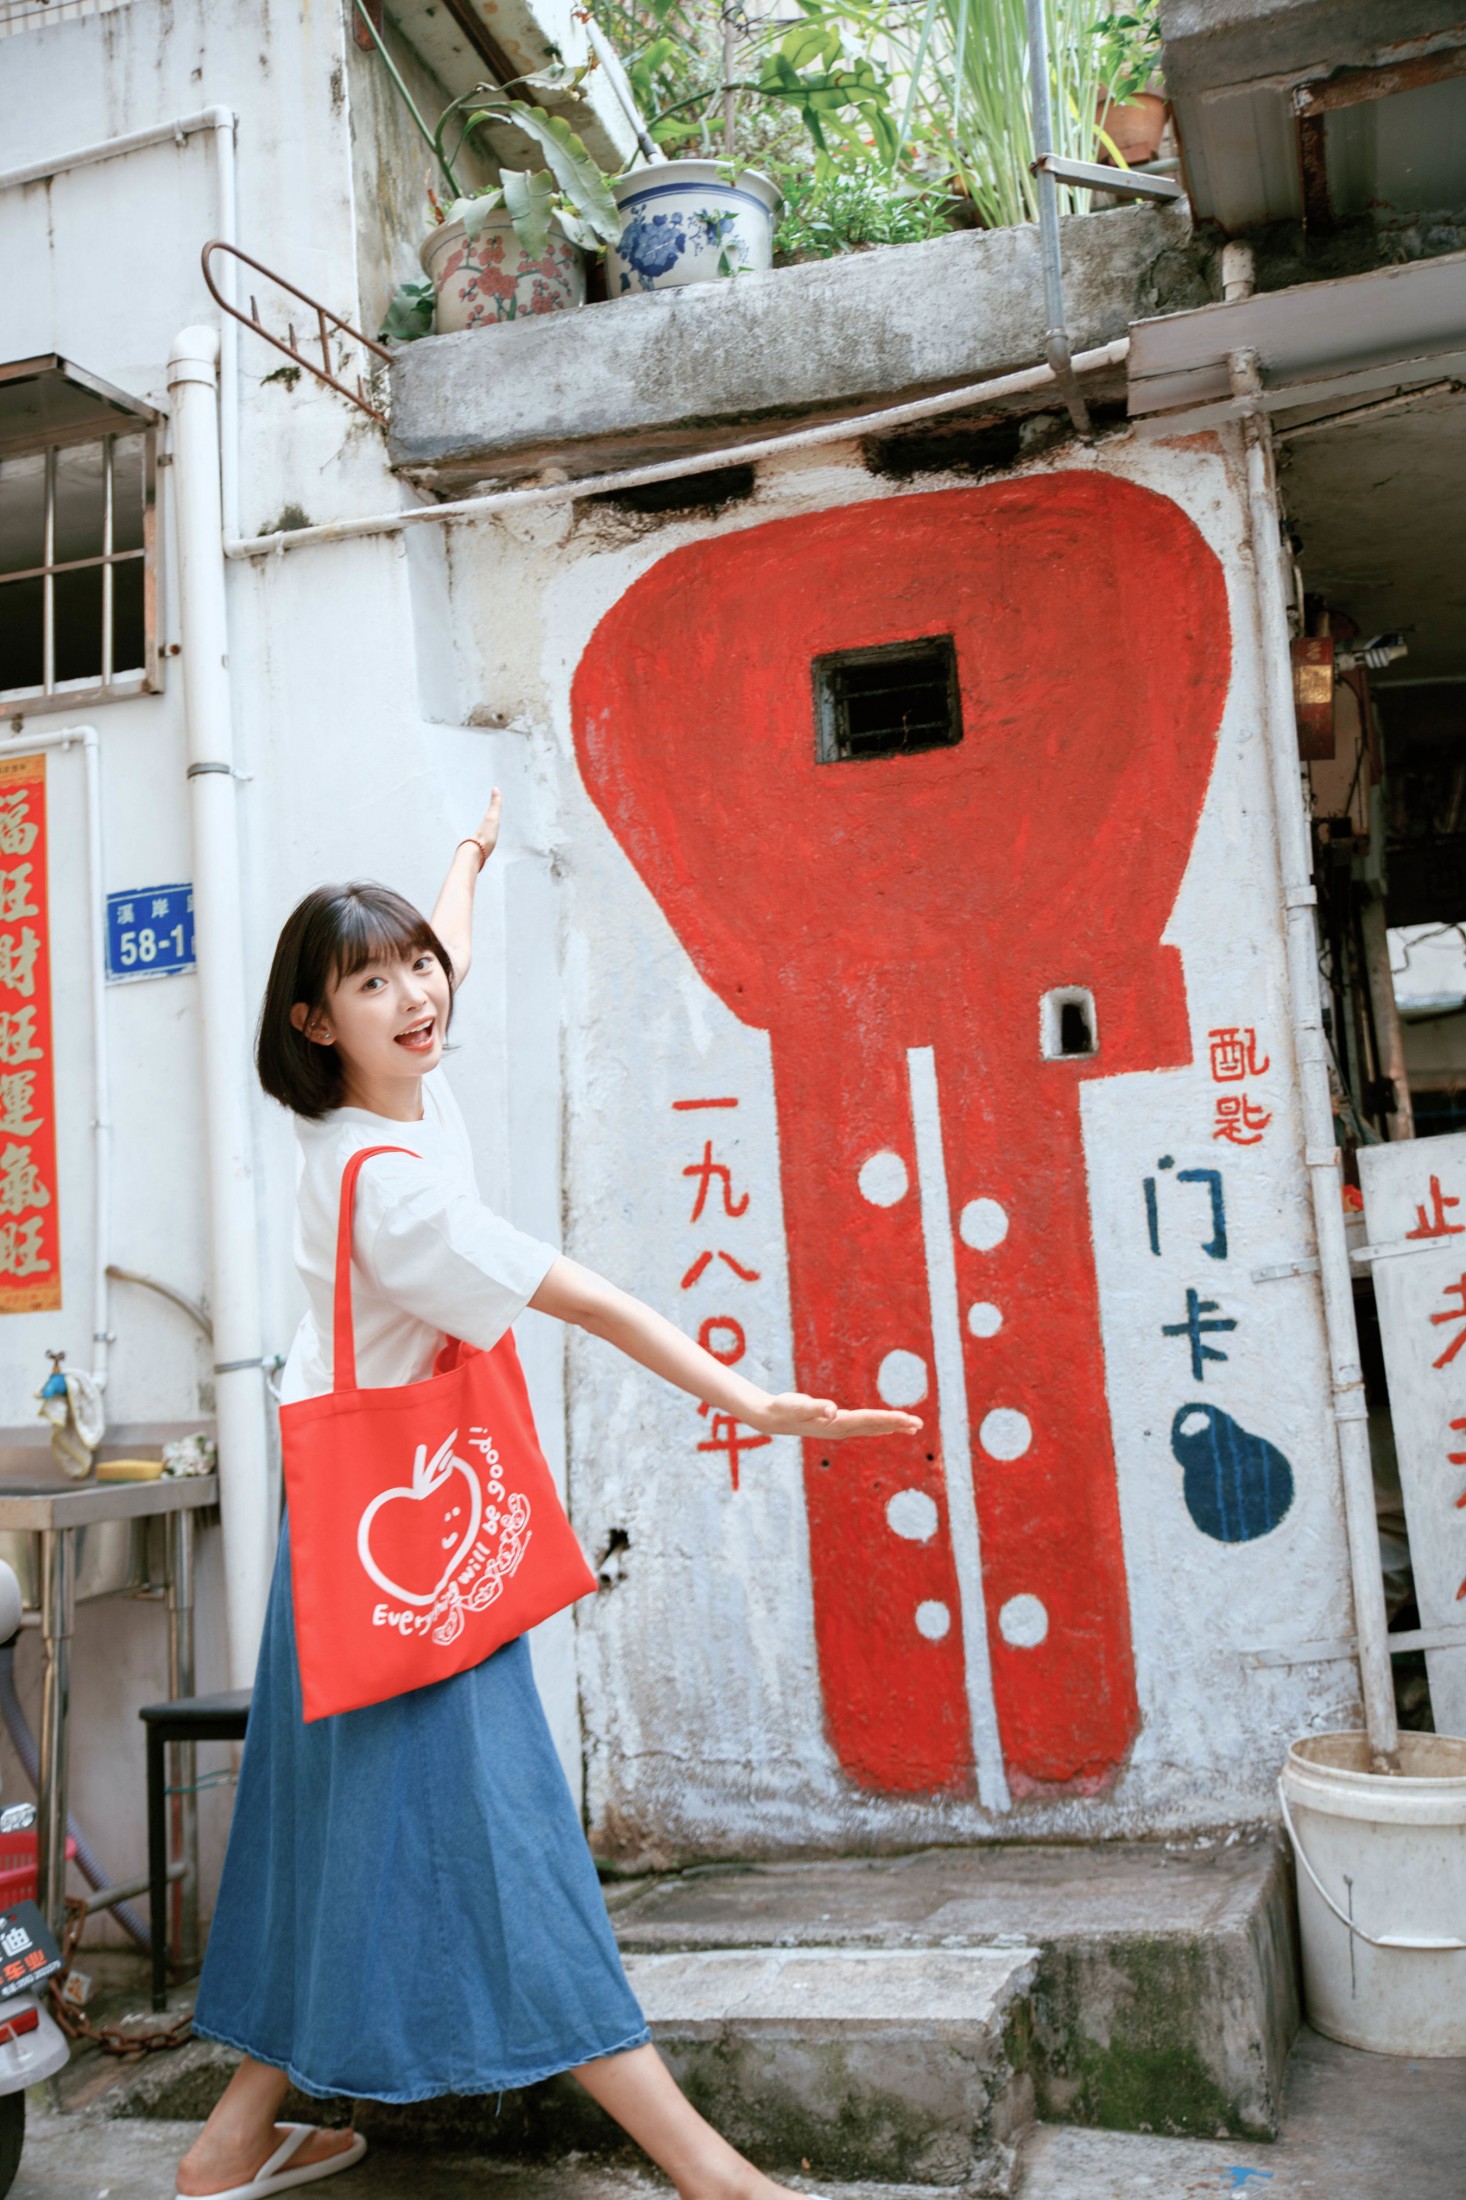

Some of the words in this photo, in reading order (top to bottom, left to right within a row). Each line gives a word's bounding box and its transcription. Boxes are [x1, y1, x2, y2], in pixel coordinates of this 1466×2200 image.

[120, 924, 195, 966] 58-1
[1143, 1154, 1238, 1382] 门卡
[457, 1541, 491, 1584] will
[481, 1504, 501, 1536] be
[0, 1927, 33, 1963] 迪
[0, 1949, 48, 1985] 车业
